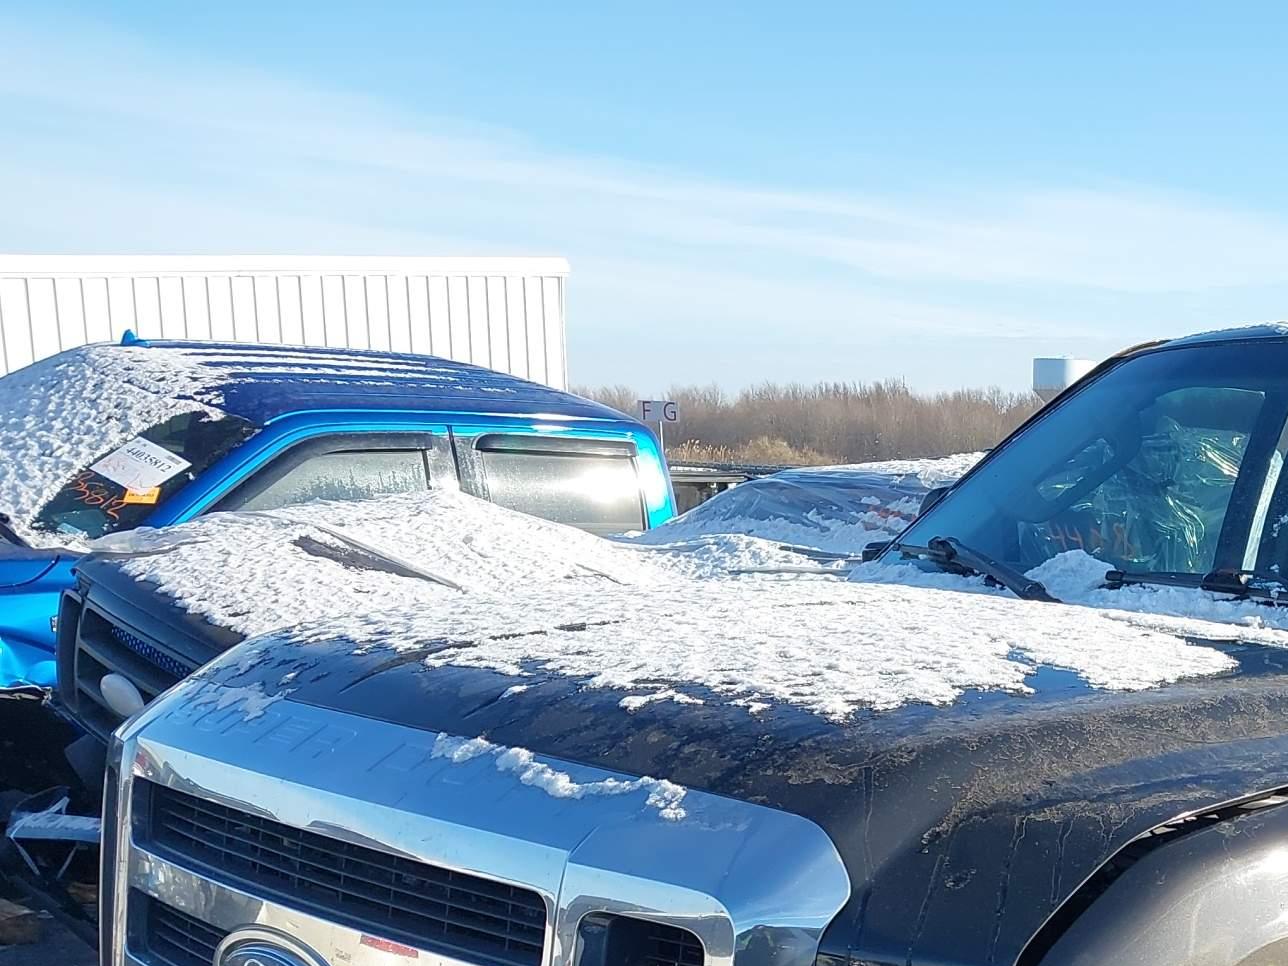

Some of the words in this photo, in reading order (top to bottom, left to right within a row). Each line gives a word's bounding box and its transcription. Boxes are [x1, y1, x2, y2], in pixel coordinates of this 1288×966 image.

[642, 401, 651, 421] F
[663, 402, 677, 421] G
[125, 446, 174, 473] 44035812
